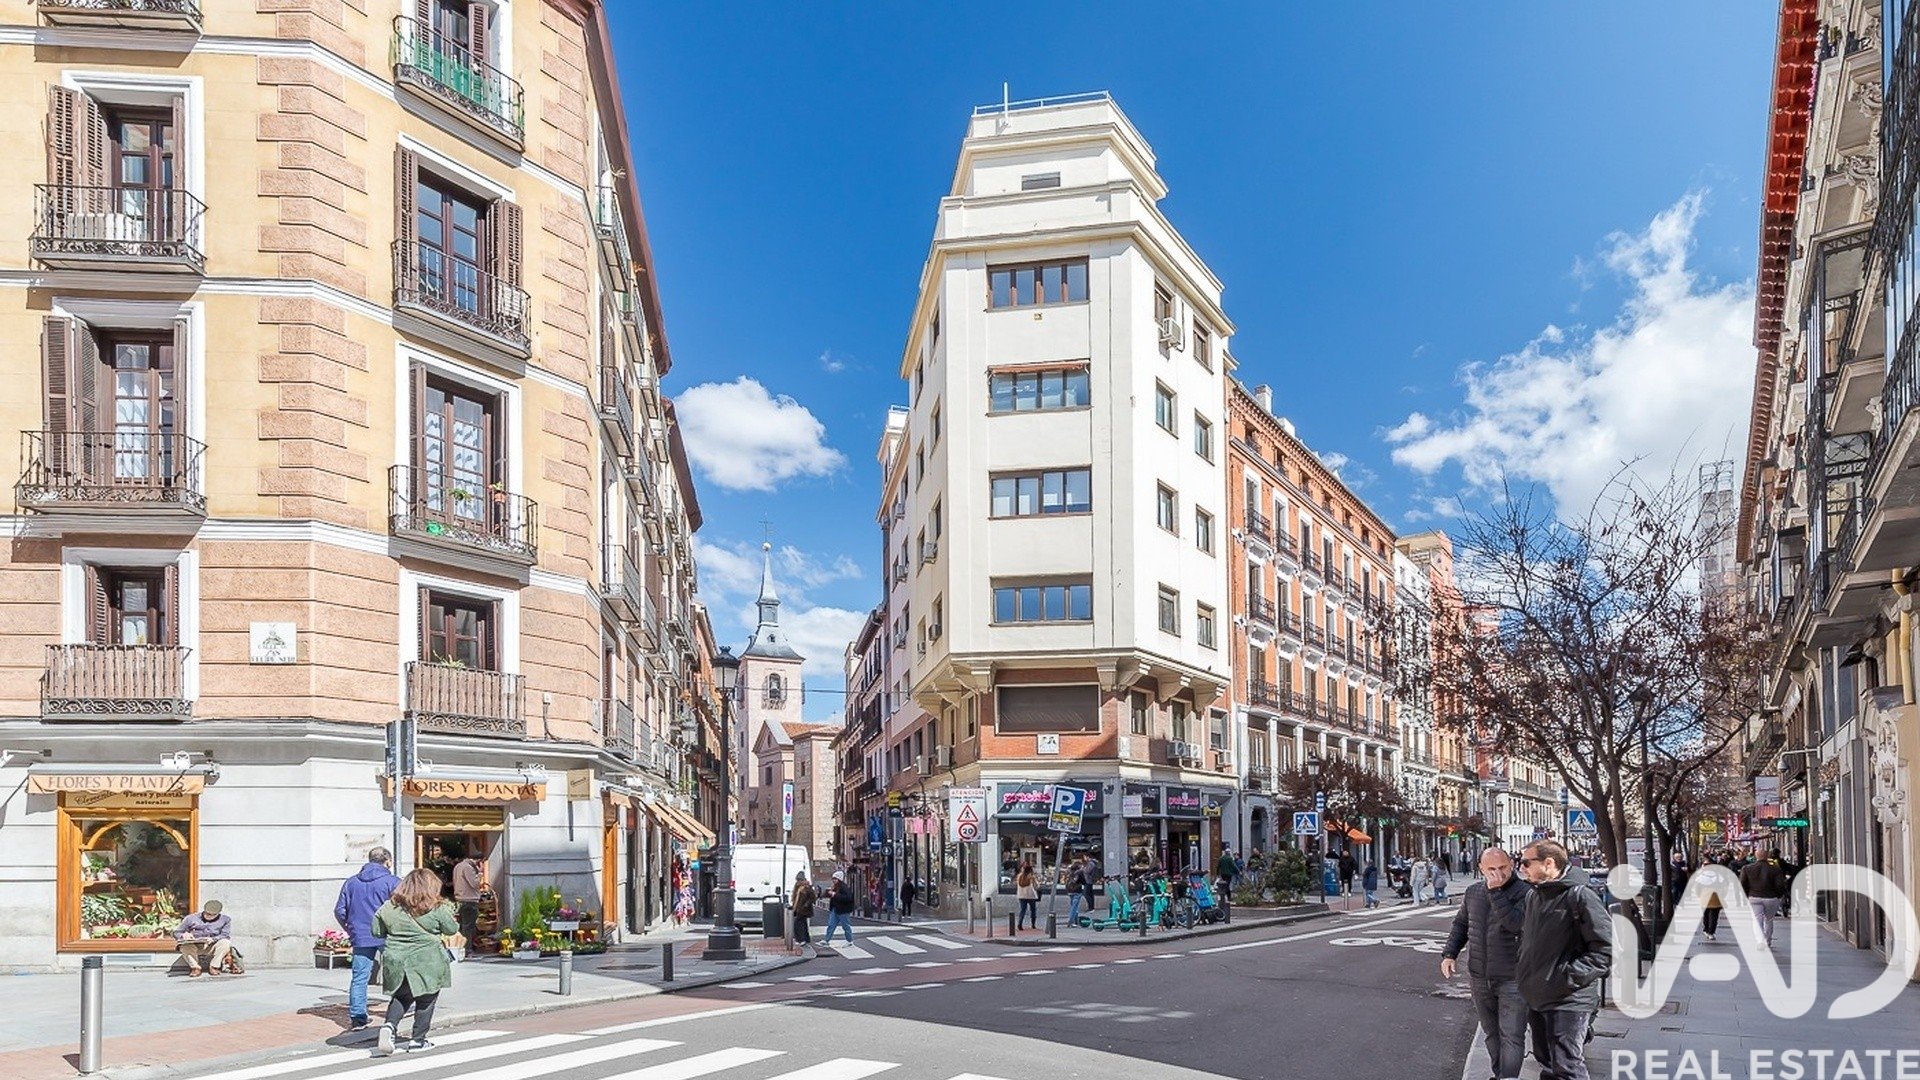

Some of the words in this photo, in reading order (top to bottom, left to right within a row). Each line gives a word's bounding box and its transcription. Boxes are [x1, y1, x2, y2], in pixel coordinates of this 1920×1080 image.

[49, 776, 101, 789] FLORES
[105, 777, 117, 788] Y
[119, 776, 185, 790] PLANTAS
[461, 783, 472, 793] Y
[475, 783, 539, 795] PLANTAS
[1055, 790, 1076, 813] P
[962, 827, 974, 835] 20
